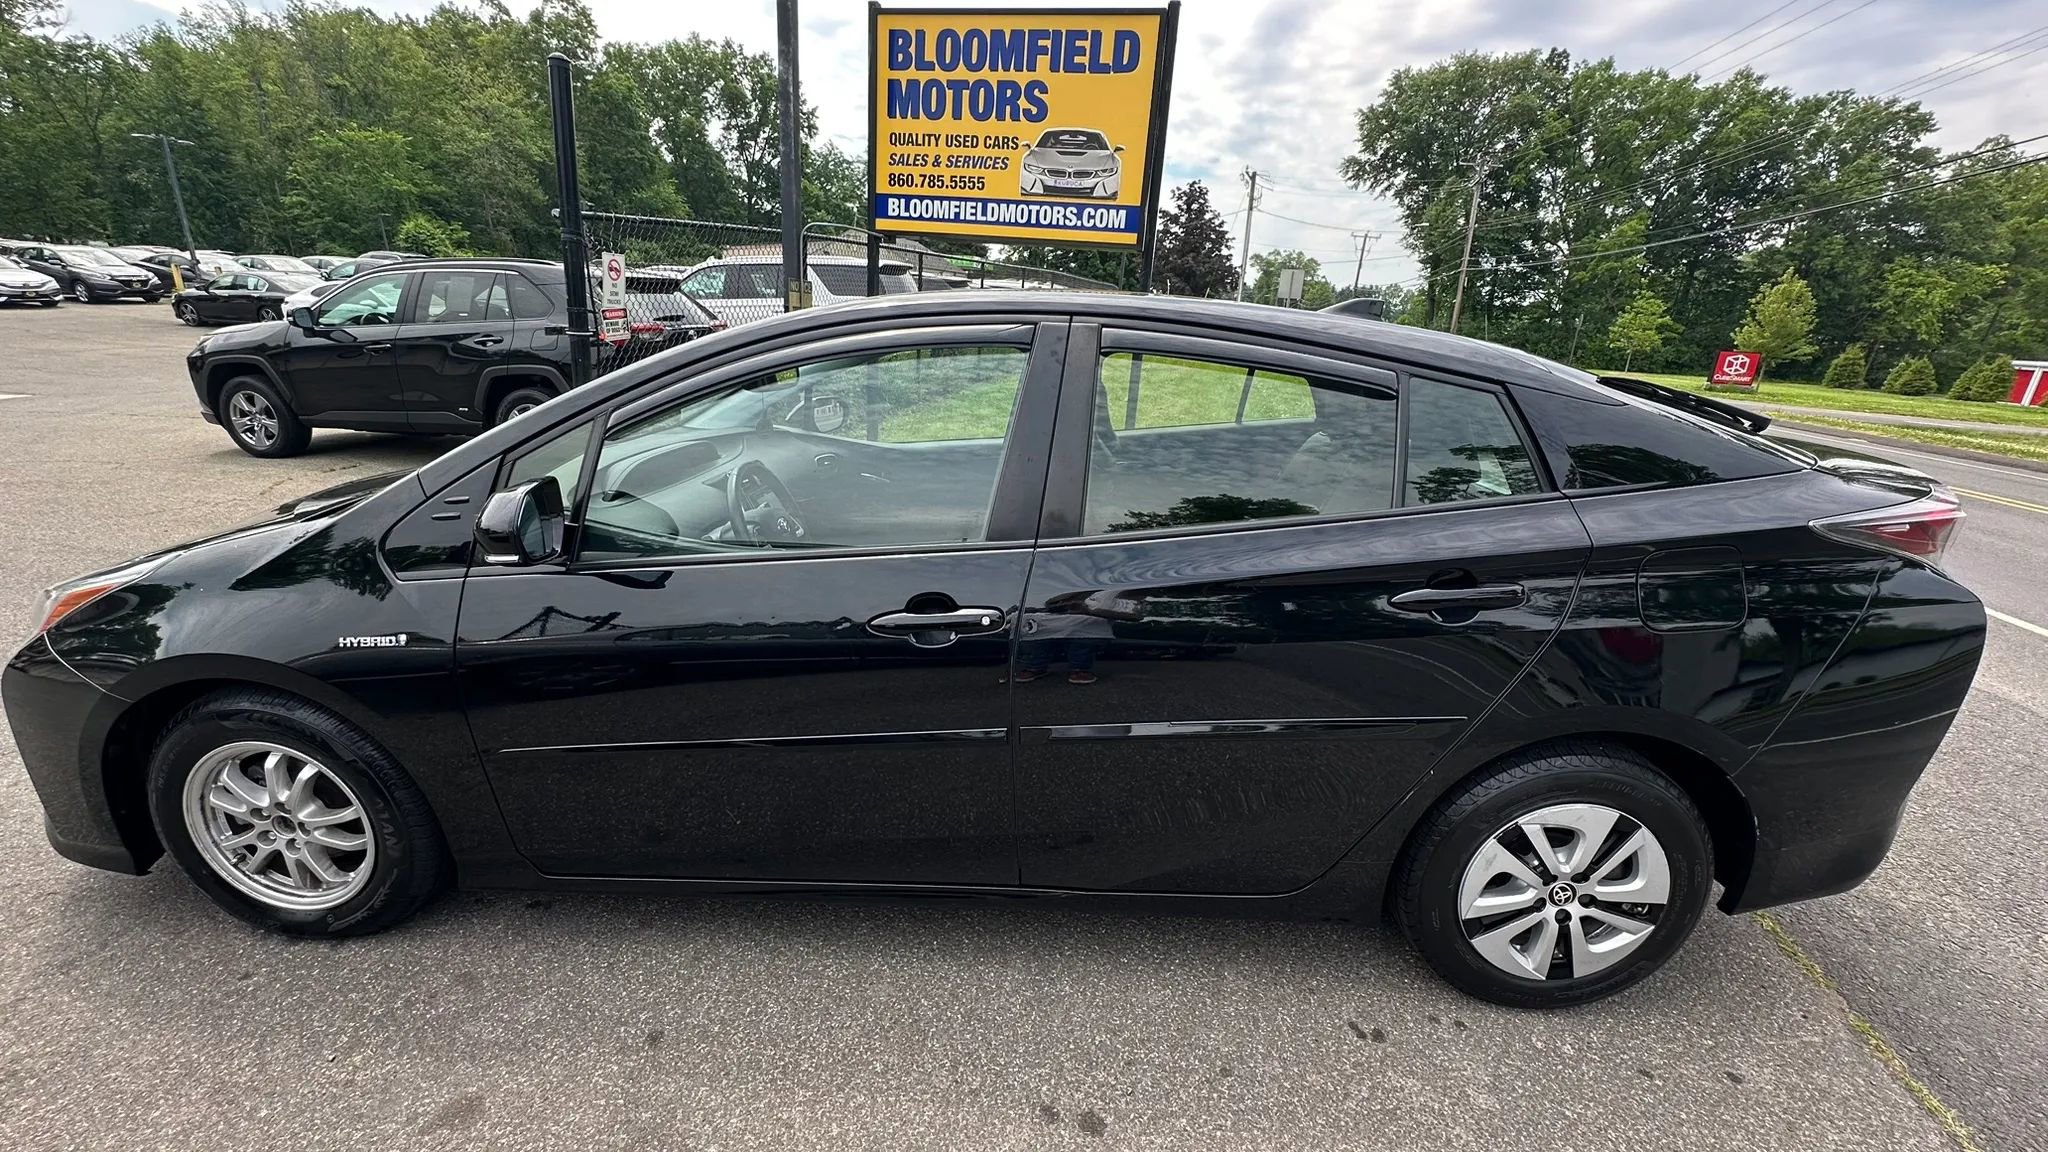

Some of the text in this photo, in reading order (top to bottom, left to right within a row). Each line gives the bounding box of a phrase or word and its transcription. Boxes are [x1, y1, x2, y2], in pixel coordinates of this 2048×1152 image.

[888, 29, 1141, 74] BLOOMFIELD
[887, 79, 1049, 122] MOTORS
[889, 132, 1019, 150] QUALITY USED CARS
[888, 153, 1010, 170] SALES & SERVICES
[888, 173, 985, 191] 860.785.5555
[887, 198, 1126, 229] BLOOMFIELDMOTORS.COM
[339, 636, 397, 647] HYBRID
